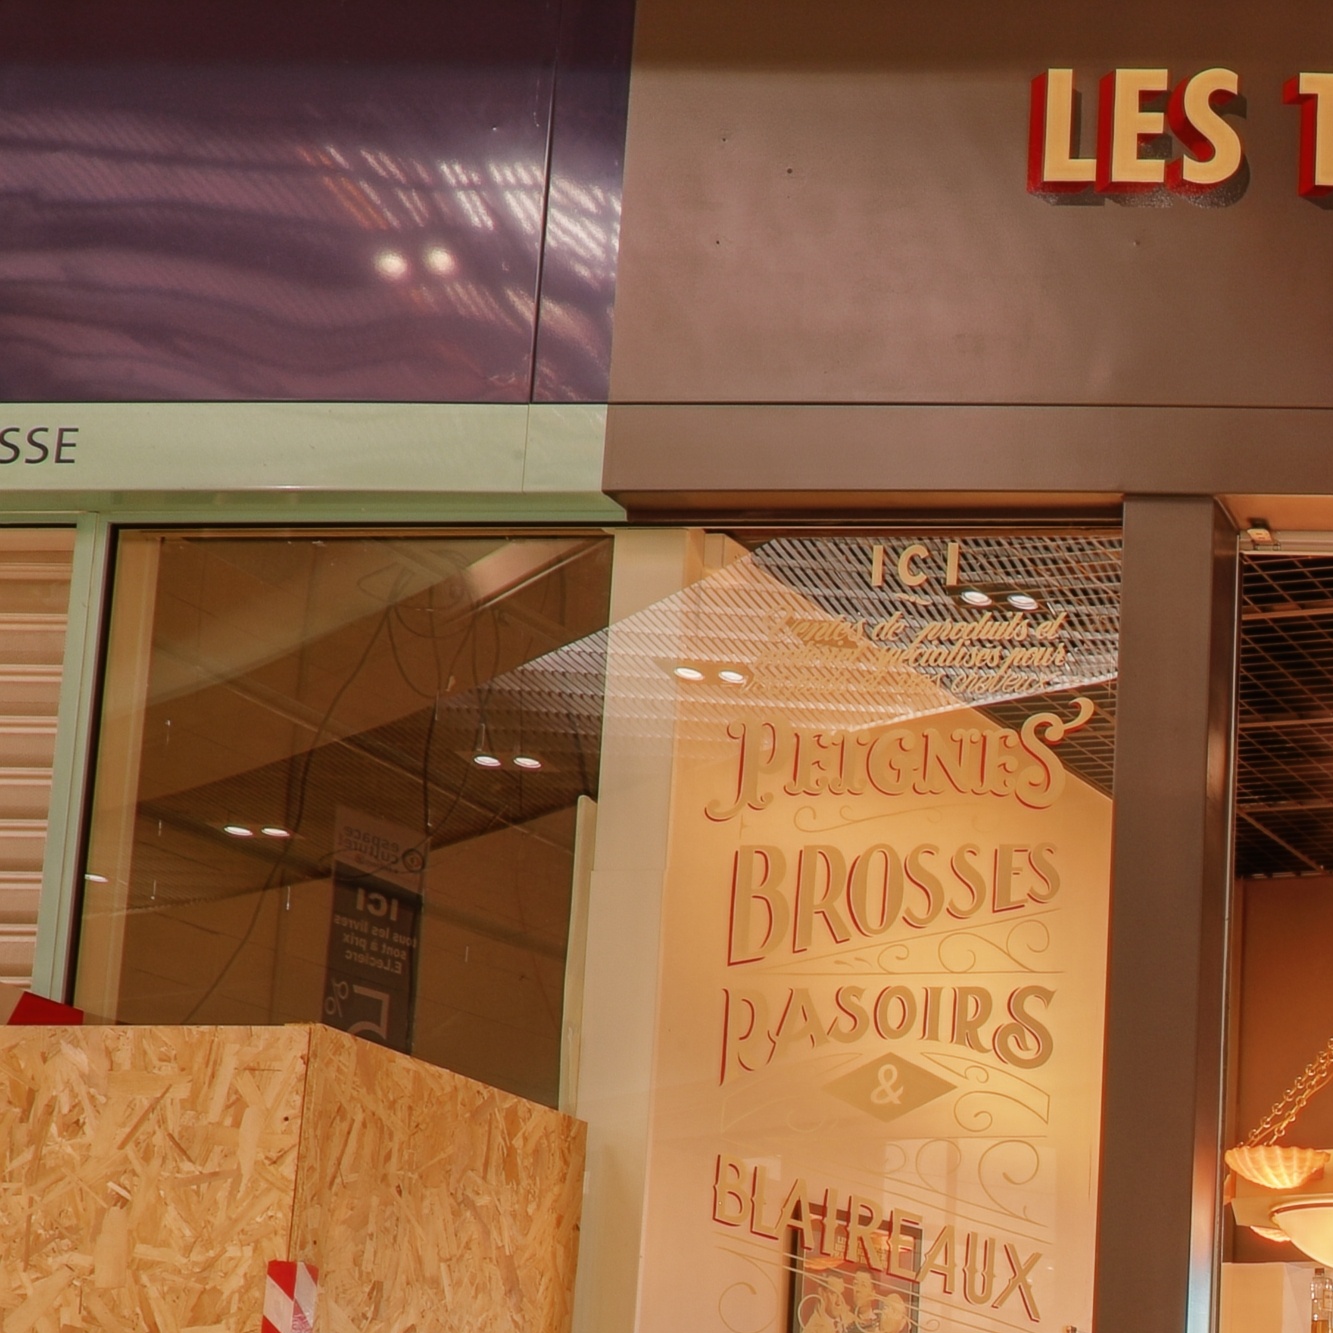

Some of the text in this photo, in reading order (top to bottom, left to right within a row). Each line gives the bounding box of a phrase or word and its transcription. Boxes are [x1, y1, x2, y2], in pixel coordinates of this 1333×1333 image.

[1027, 68, 1244, 192] LES
[0, 427, 79, 464] SSE
[871, 542, 960, 587] ICI
[872, 611, 906, 641] de
[908, 611, 1030, 649] produits
[1036, 611, 1068, 640] et
[997, 642, 1066, 682] pour
[705, 697, 1095, 822] PEIGNES
[728, 842, 1062, 967] BROSSES
[719, 984, 1057, 1087] RASOIRS
[870, 1063, 905, 1105] &
[712, 1154, 1042, 1323] BLAIREAUX
